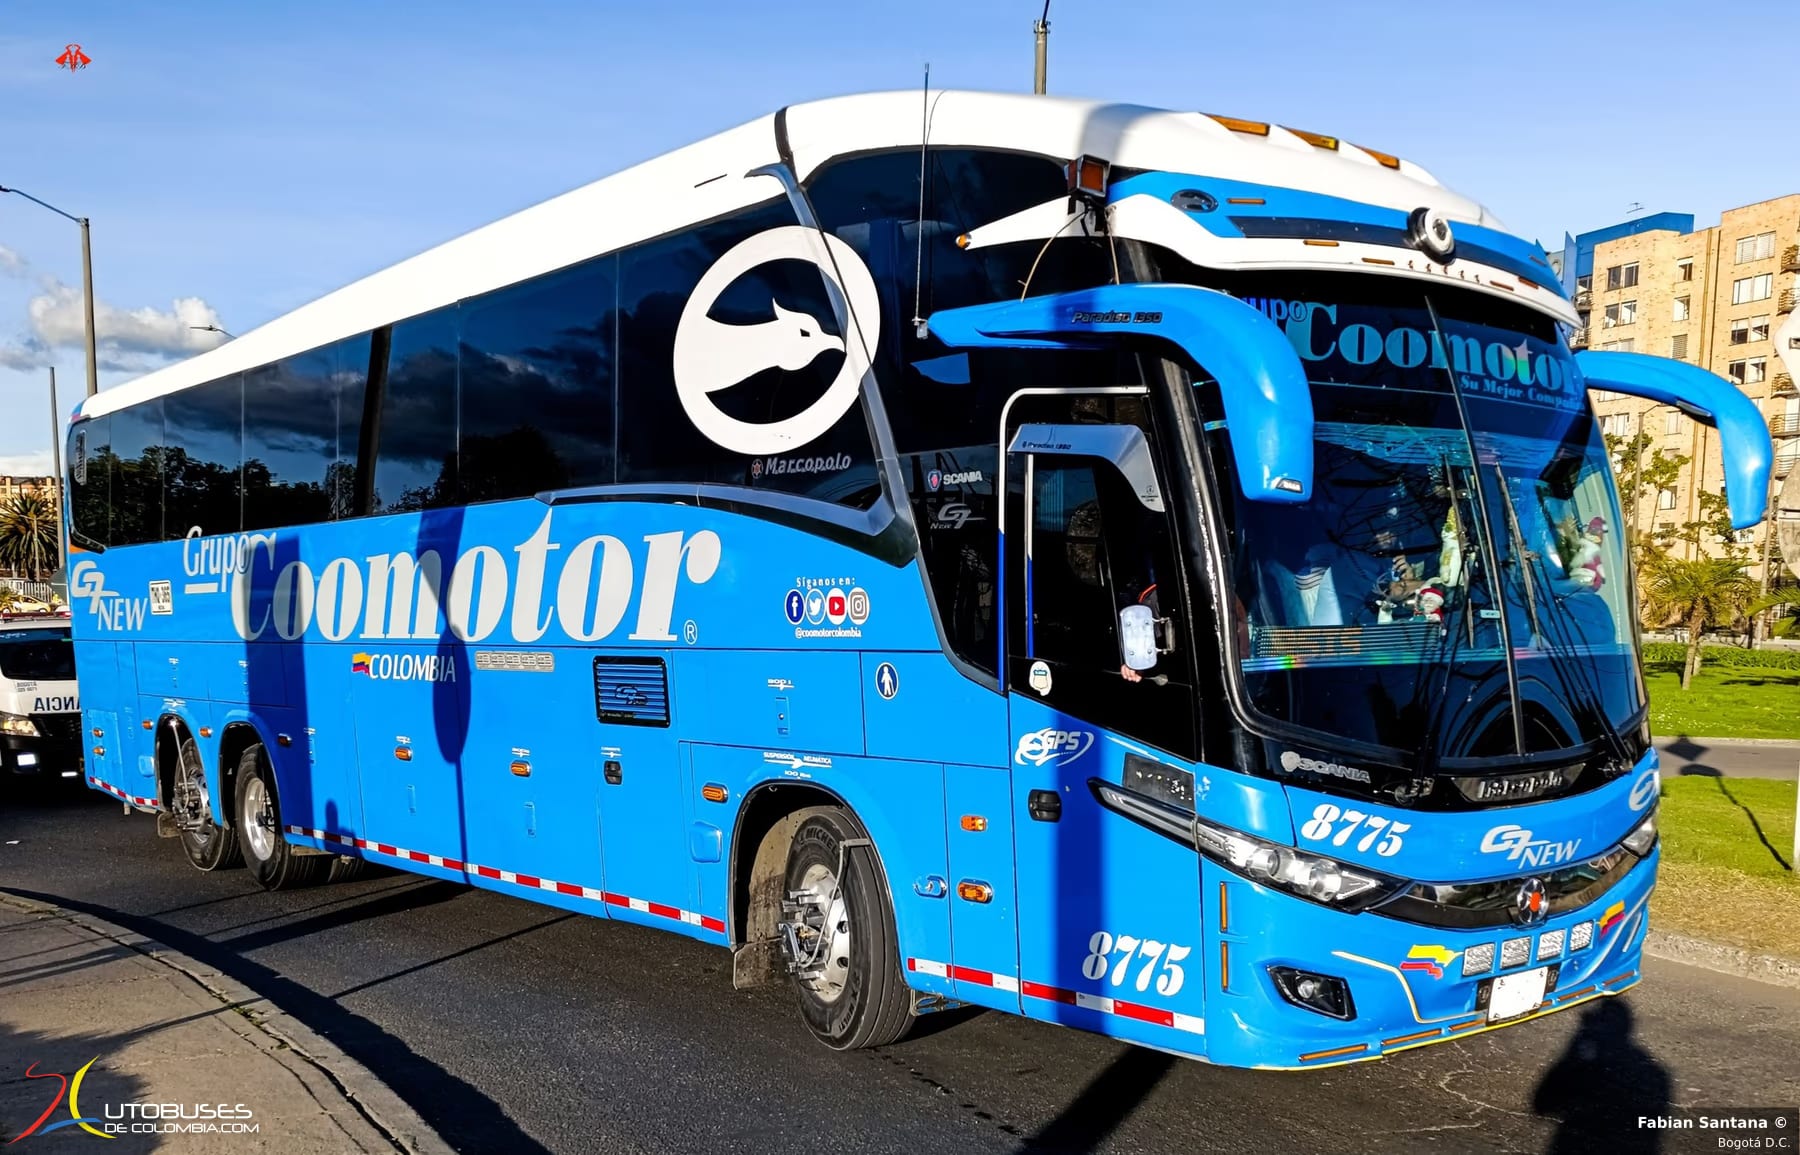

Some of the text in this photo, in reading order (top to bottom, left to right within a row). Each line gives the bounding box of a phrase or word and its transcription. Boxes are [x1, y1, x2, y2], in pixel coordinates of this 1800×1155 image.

[1071, 310, 1131, 323] Paradiso
[1461, 374, 1479, 391] Su
[1483, 379, 1523, 399] Mejor
[765, 452, 852, 475] Marcopolo
[943, 470, 983, 485] SCANIA
[183, 525, 251, 593] Grupo
[231, 507, 722, 642] Coomotor
[796, 576, 836, 590] Síganos
[98, 597, 148, 631] NEW
[795, 626, 862, 639] @coomotorcolombia
[369, 654, 456, 682] COLOMBIA
[1042, 730, 1081, 750] GPS
[1298, 757, 1371, 784] SCANIA
[1301, 803, 1412, 857] 8775
[1518, 838, 1582, 870] NEW
[1082, 931, 1192, 997] 8775
